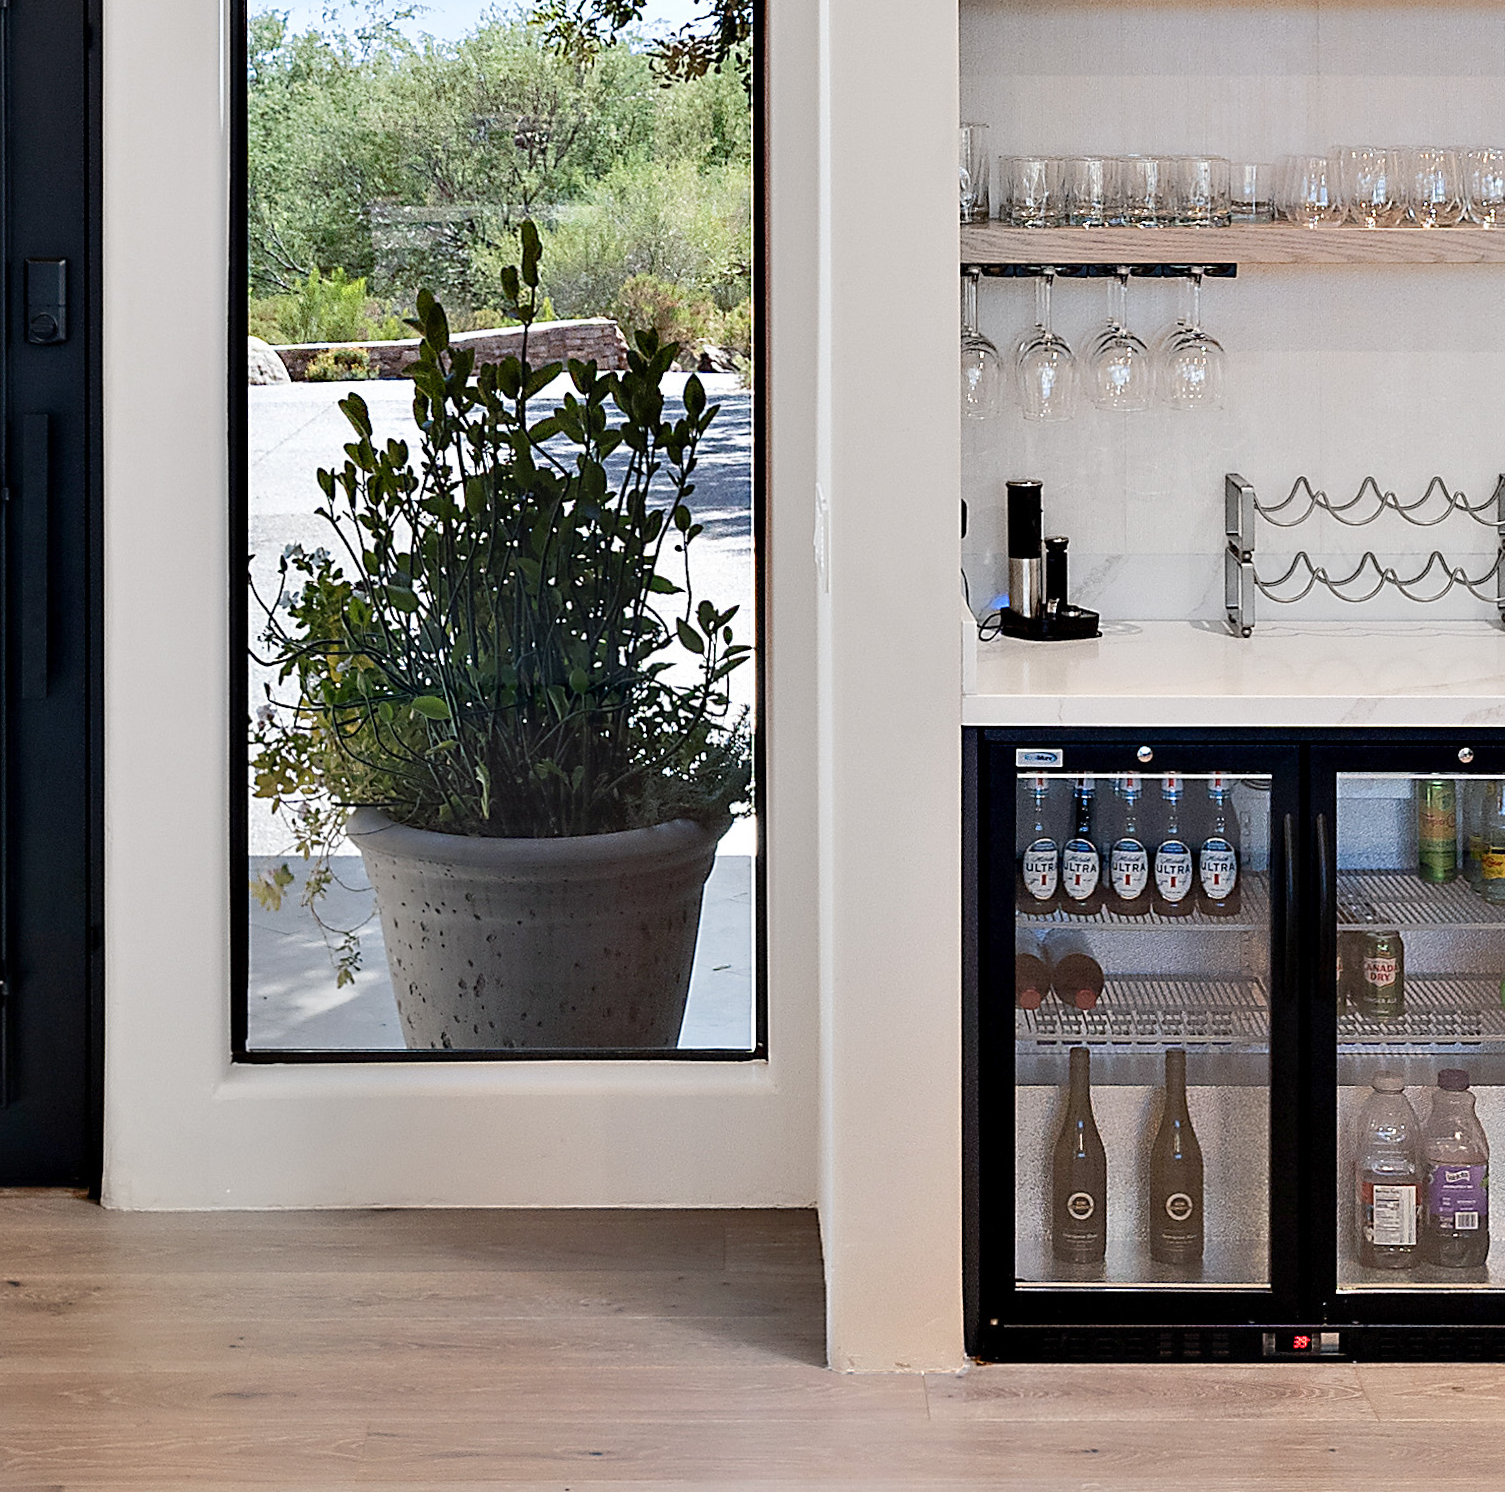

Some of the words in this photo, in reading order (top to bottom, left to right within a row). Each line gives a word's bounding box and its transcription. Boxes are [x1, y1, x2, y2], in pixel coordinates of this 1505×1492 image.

[1026, 863, 1055, 873] ULTR
[1156, 864, 1191, 874] ULTRA
[1364, 962, 1400, 972] ANAD
[1370, 972, 1391, 981] DRY
